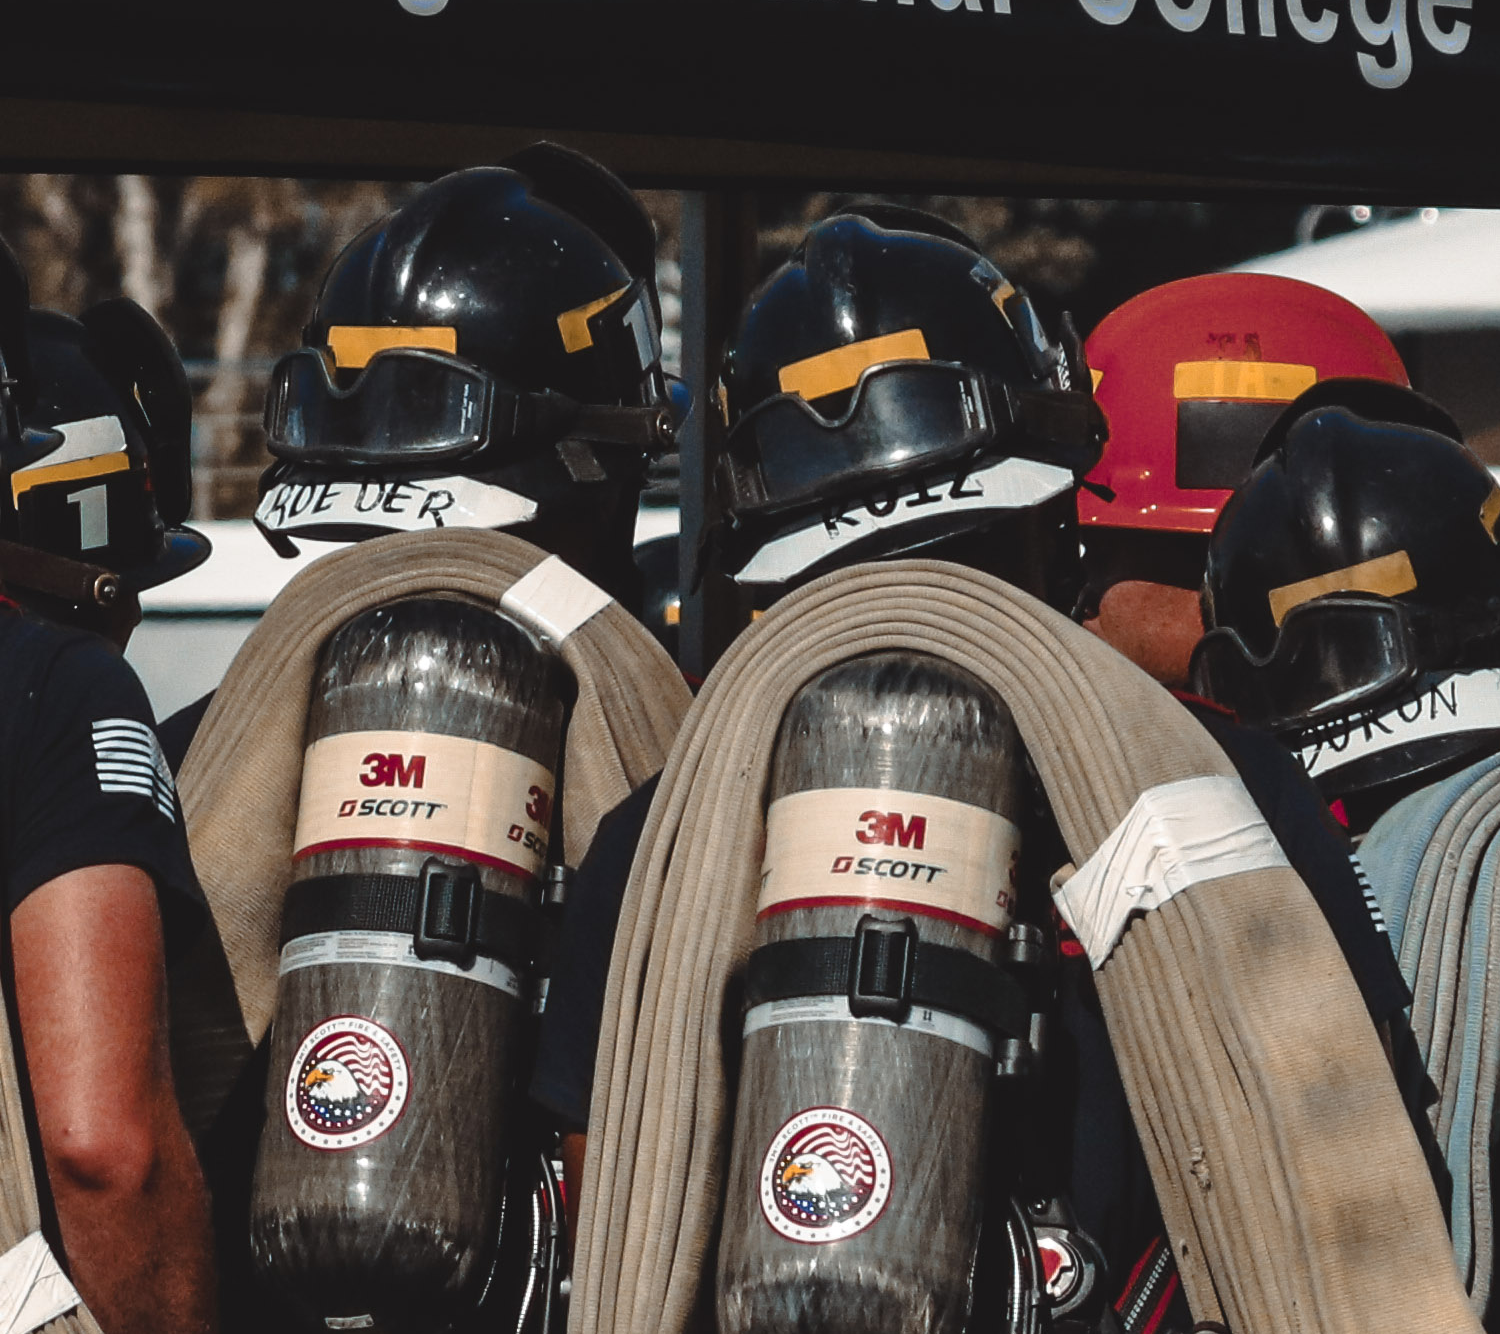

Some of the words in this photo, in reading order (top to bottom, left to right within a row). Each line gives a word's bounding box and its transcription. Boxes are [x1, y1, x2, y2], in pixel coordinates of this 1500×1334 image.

[66, 483, 111, 551] 1
[358, 752, 427, 790] 3M
[357, 799, 440, 821] SCOTT
[855, 810, 928, 852] 3M
[854, 856, 941, 885] SCOTT
